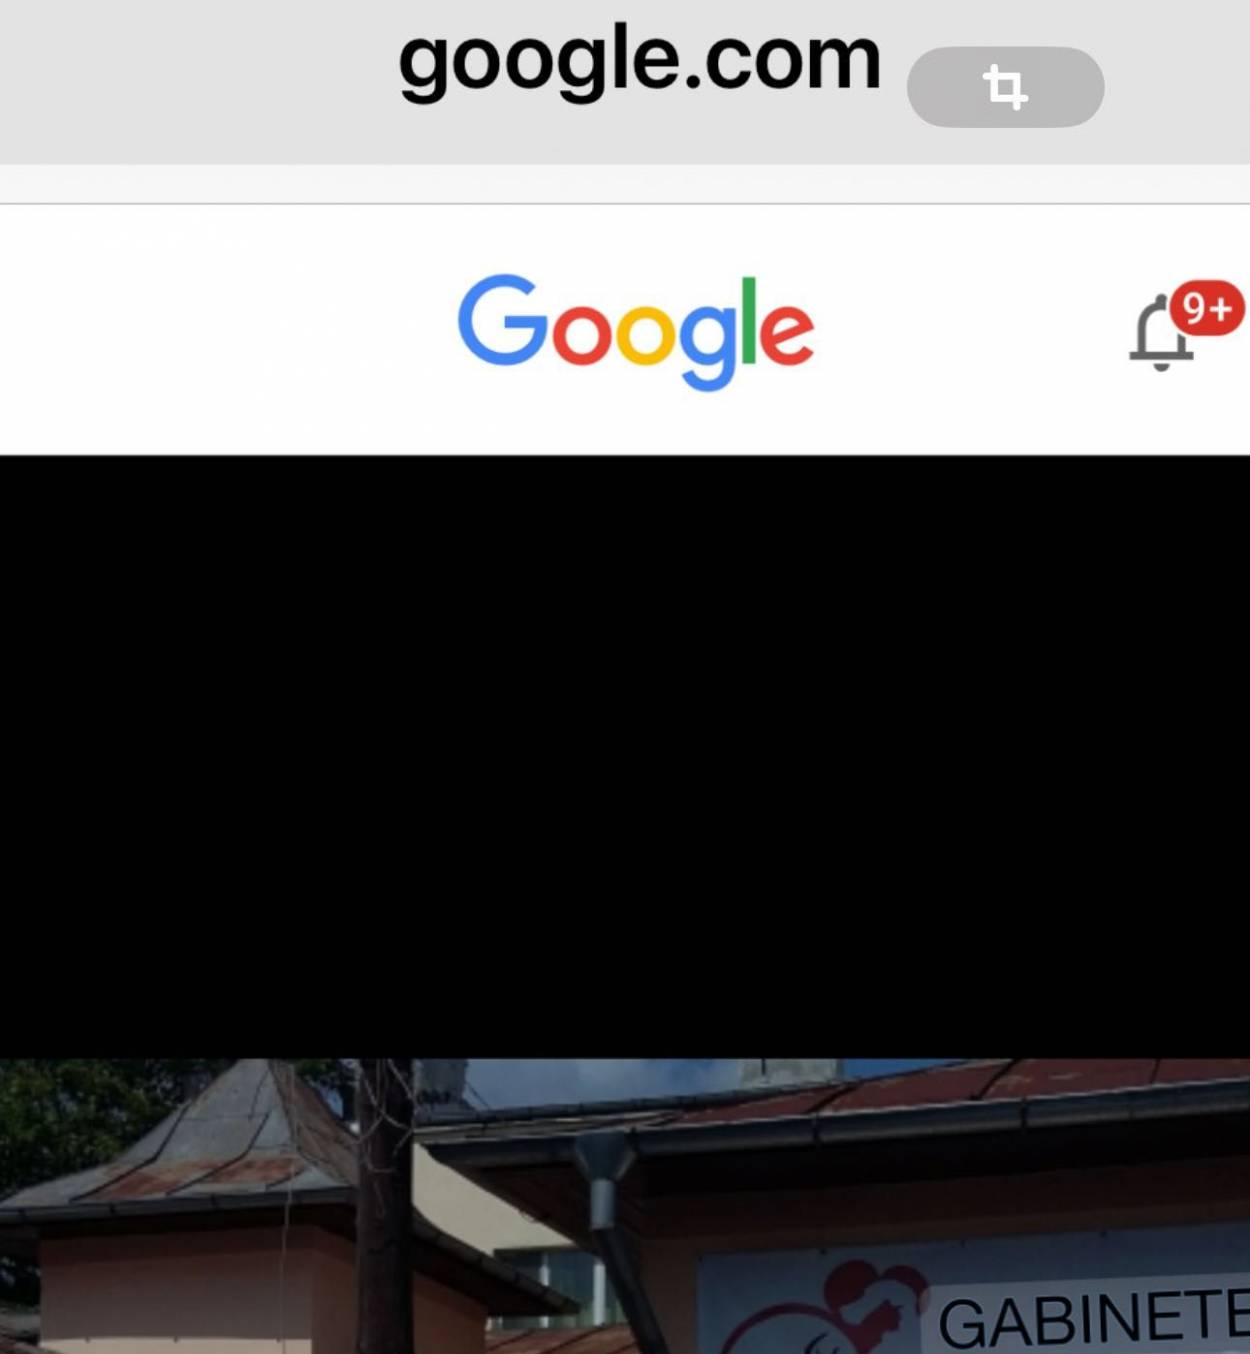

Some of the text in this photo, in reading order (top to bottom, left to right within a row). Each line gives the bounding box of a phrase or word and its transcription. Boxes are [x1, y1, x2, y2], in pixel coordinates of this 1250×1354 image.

[400, 22, 880, 104] google.com
[458, 274, 814, 392] Google
[1184, 291, 1232, 325] 9+
